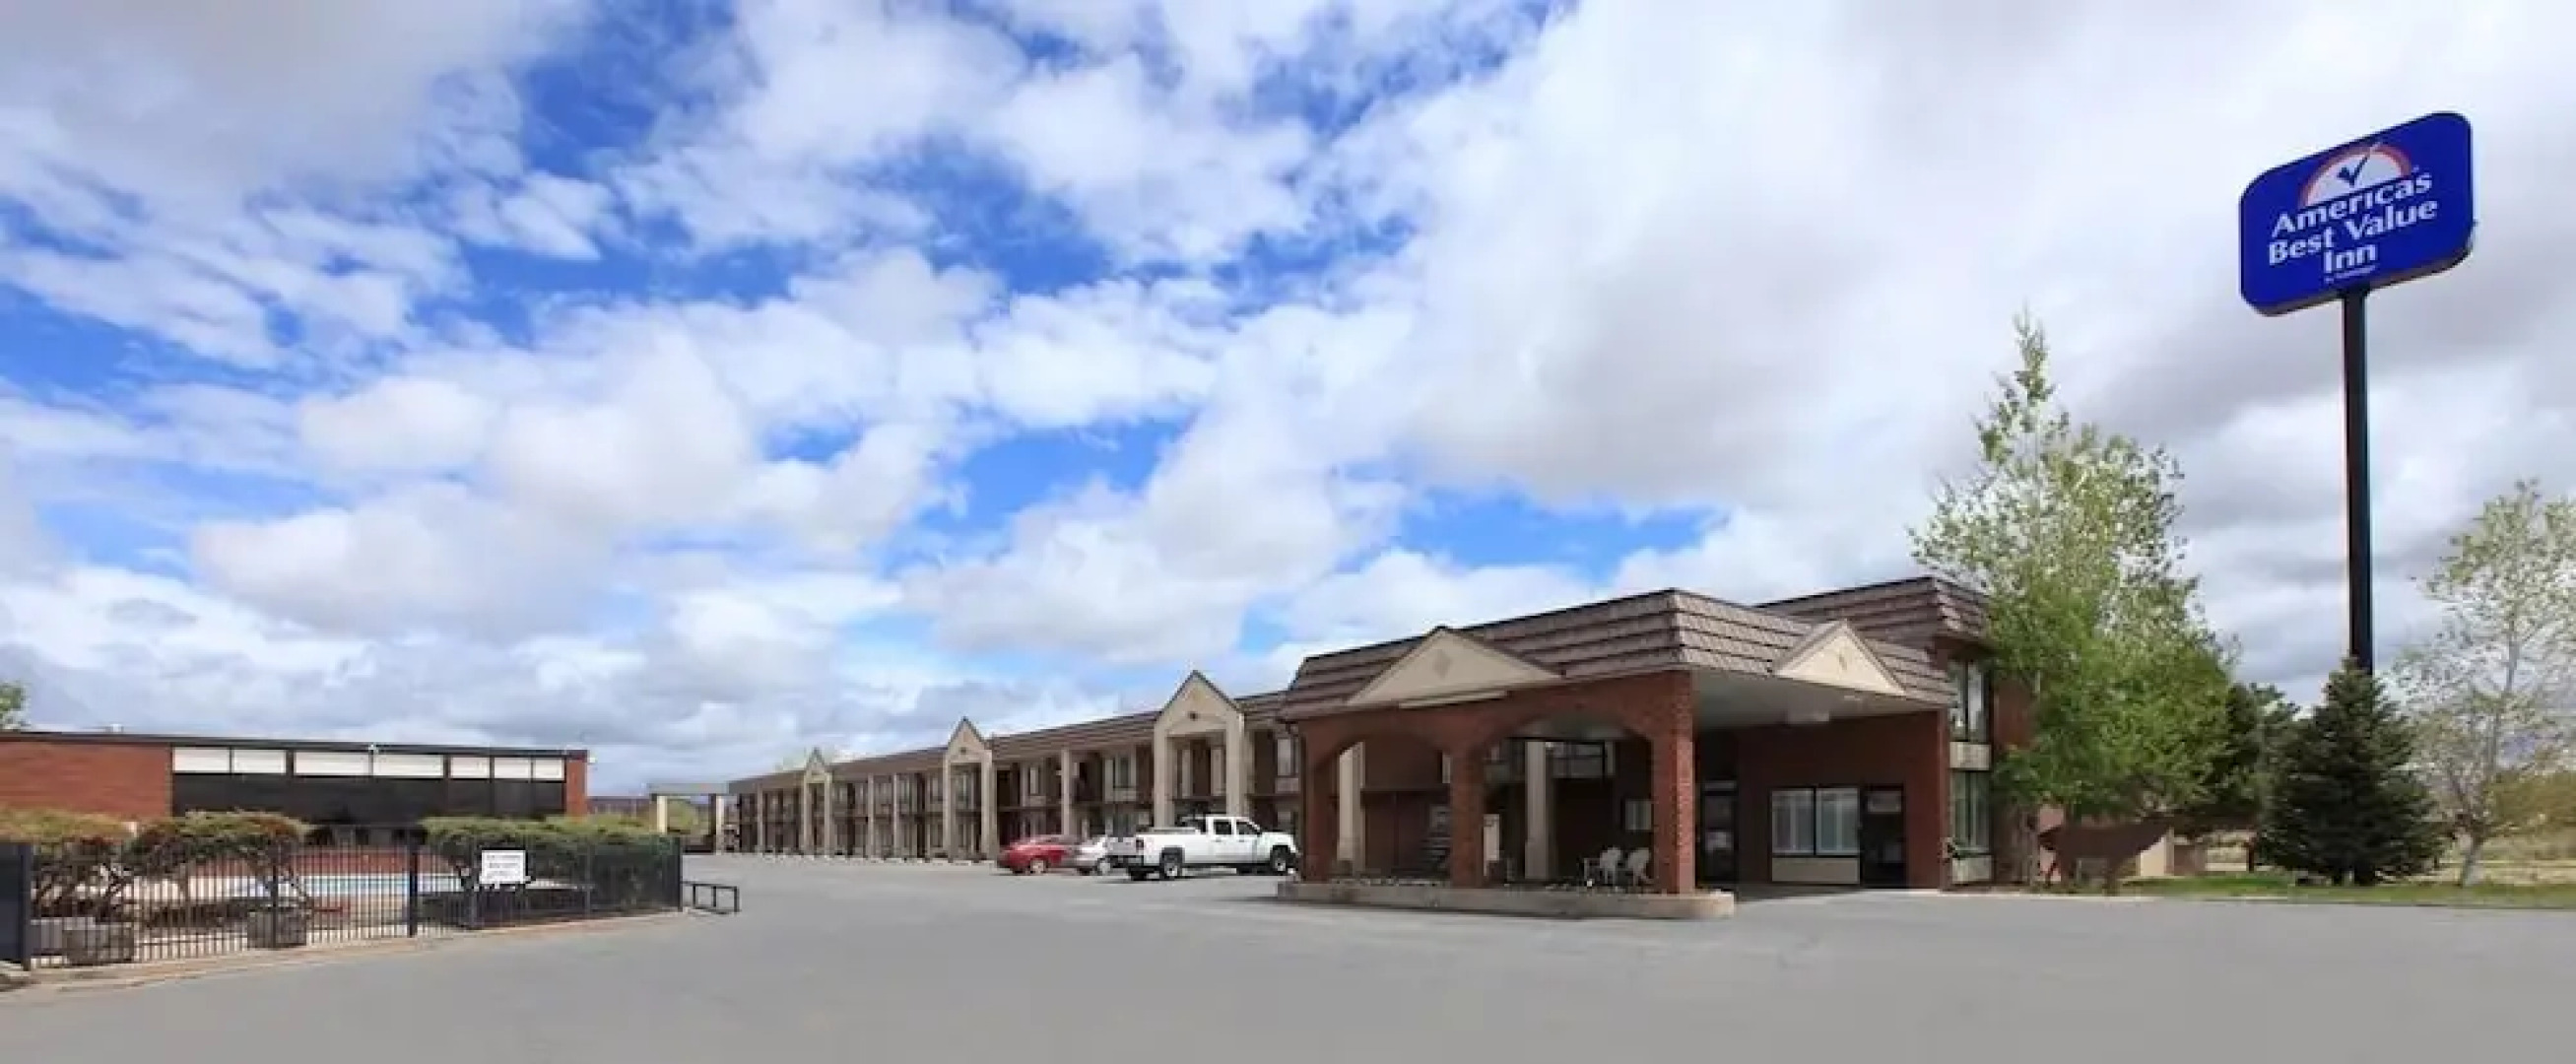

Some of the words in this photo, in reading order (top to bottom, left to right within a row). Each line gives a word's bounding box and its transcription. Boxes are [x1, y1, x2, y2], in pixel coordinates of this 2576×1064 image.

[2269, 226, 2335, 266] Best
[2344, 200, 2438, 240] Value
[2271, 170, 2433, 238] Americas
[2323, 244, 2376, 274] Inn
